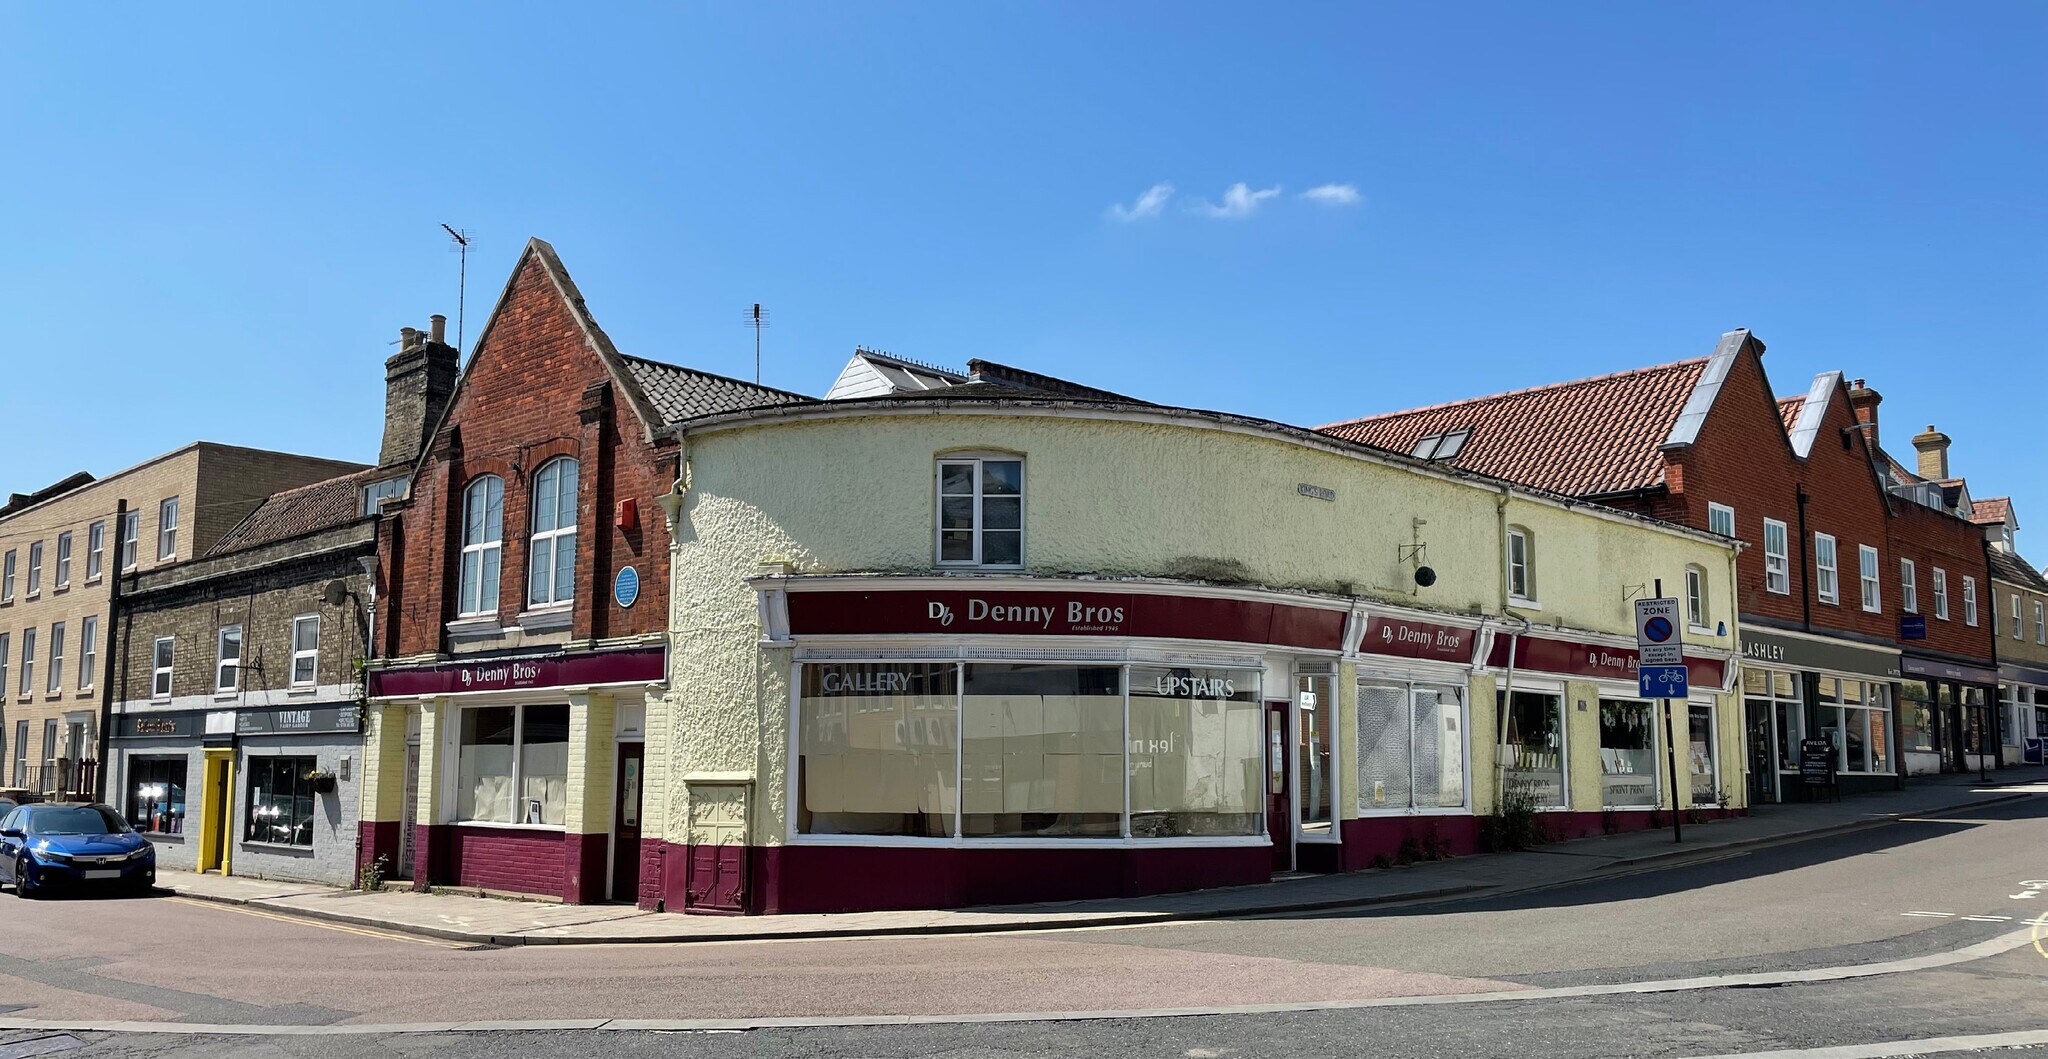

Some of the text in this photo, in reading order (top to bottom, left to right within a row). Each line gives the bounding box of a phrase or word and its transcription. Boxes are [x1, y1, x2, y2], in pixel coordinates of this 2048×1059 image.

[968, 599, 1055, 629] Denny
[1068, 602, 1124, 622] Bros
[1644, 607, 1670, 615] ZONE
[1399, 626, 1433, 649] Denny
[1437, 631, 1460, 648] Bros
[1601, 652, 1626, 671] Denny
[1628, 656, 1640, 668] Bro
[476, 667, 509, 685] Denny
[513, 663, 536, 679] Bros
[823, 672, 912, 691] GALLERY
[1157, 676, 1234, 697] UPSTAIRS
[279, 710, 311, 723] VINTAGE
